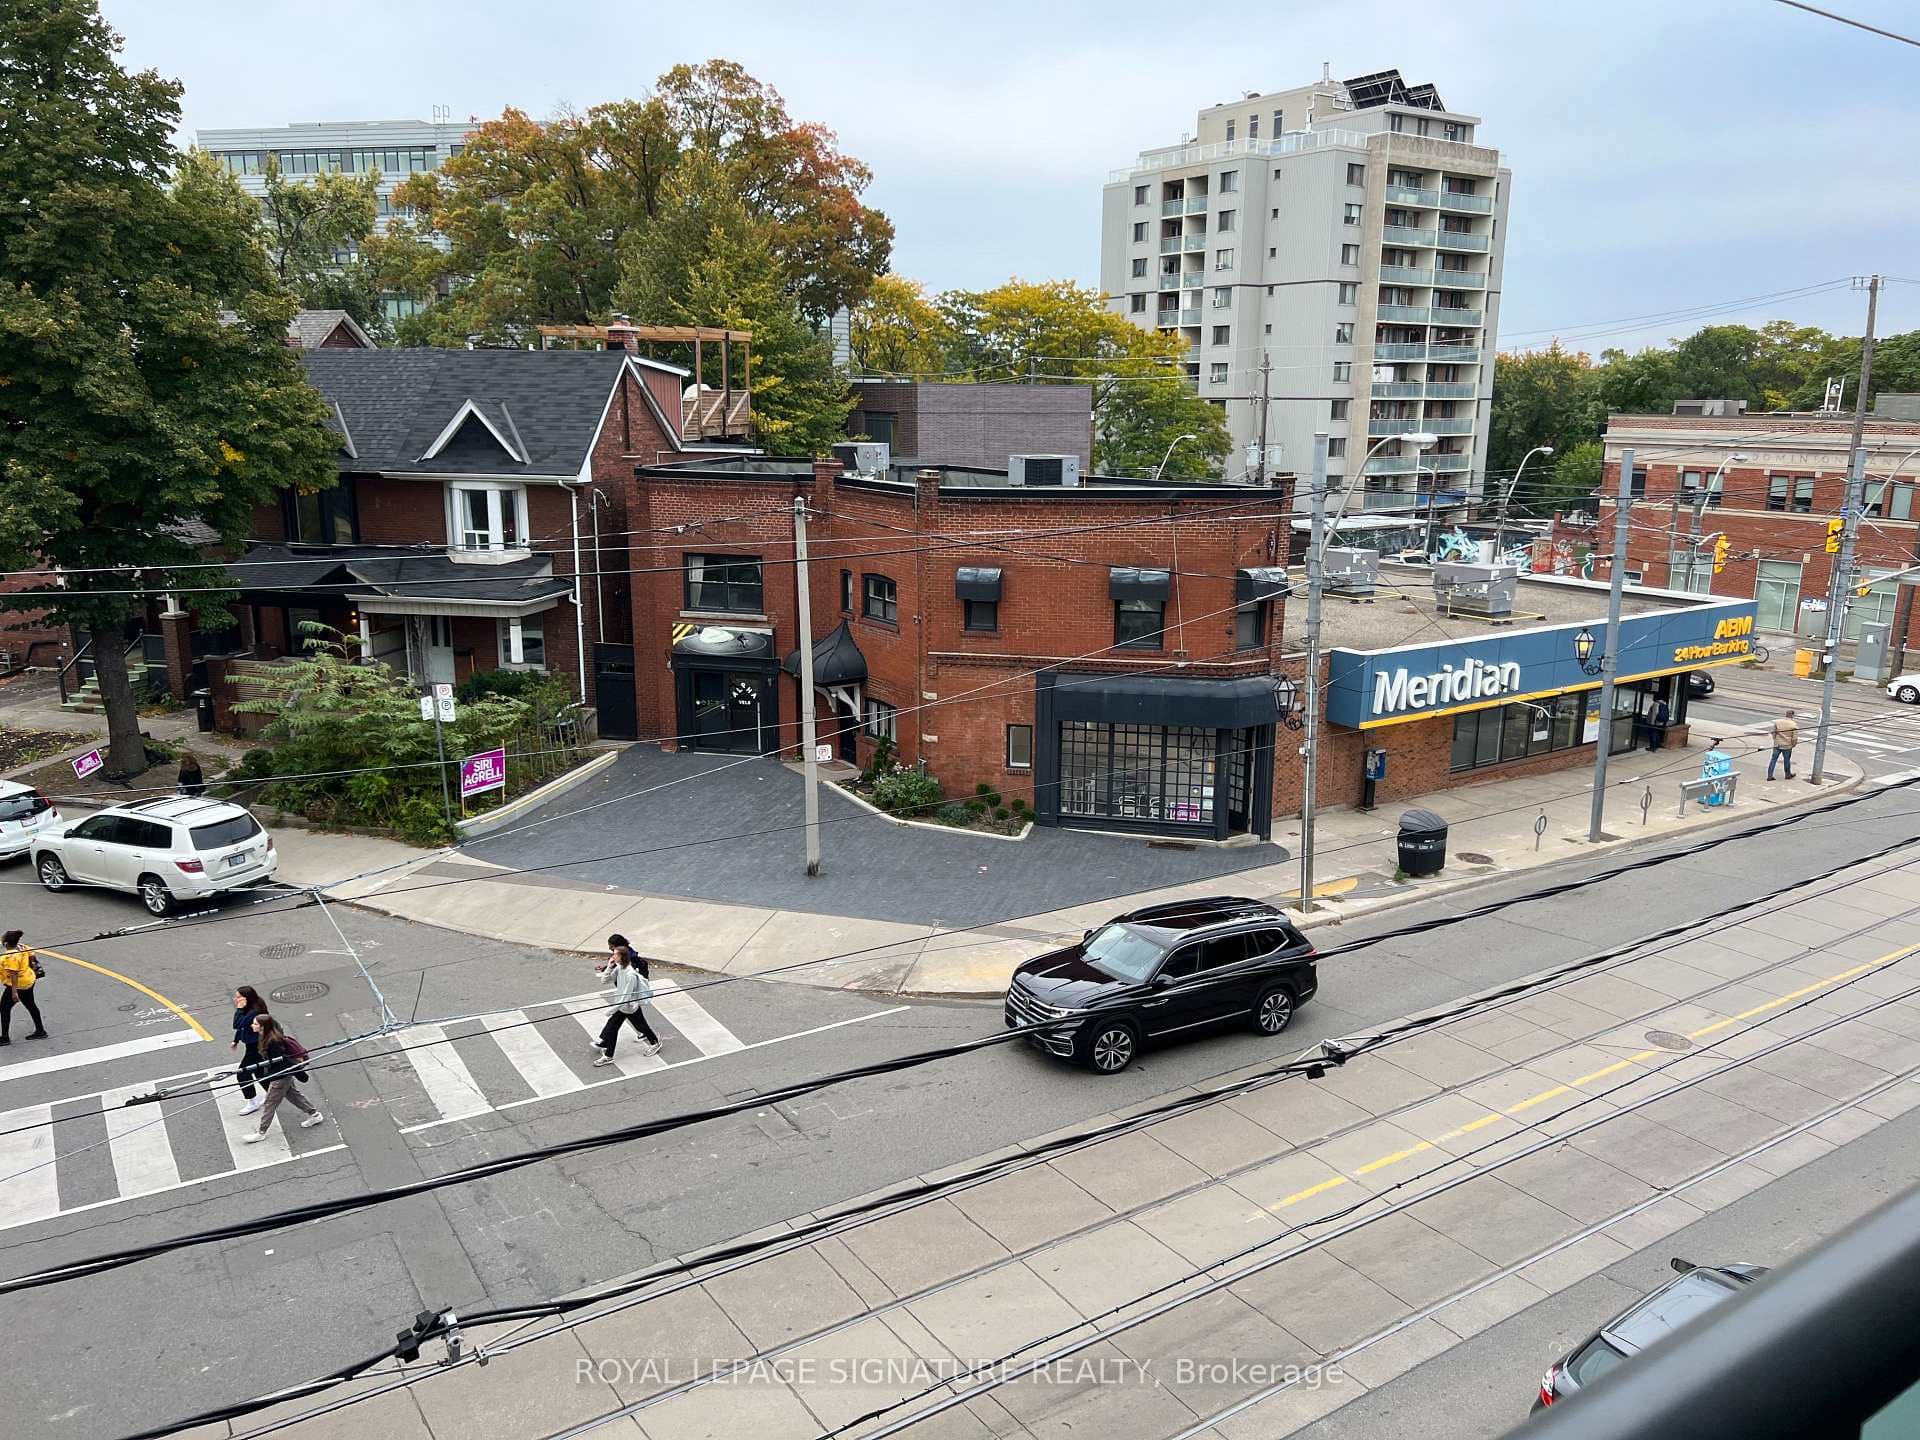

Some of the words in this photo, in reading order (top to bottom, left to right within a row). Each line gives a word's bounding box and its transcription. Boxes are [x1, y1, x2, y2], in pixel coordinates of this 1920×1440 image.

[1713, 615, 1752, 640] ABM
[1689, 645, 1712, 660] Hour
[1712, 639, 1749, 656] Banking
[732, 682, 757, 700] ALPHA
[1372, 657, 1520, 714] Meridian
[473, 758, 493, 772] SIRI
[464, 766, 503, 787] AGRELL
